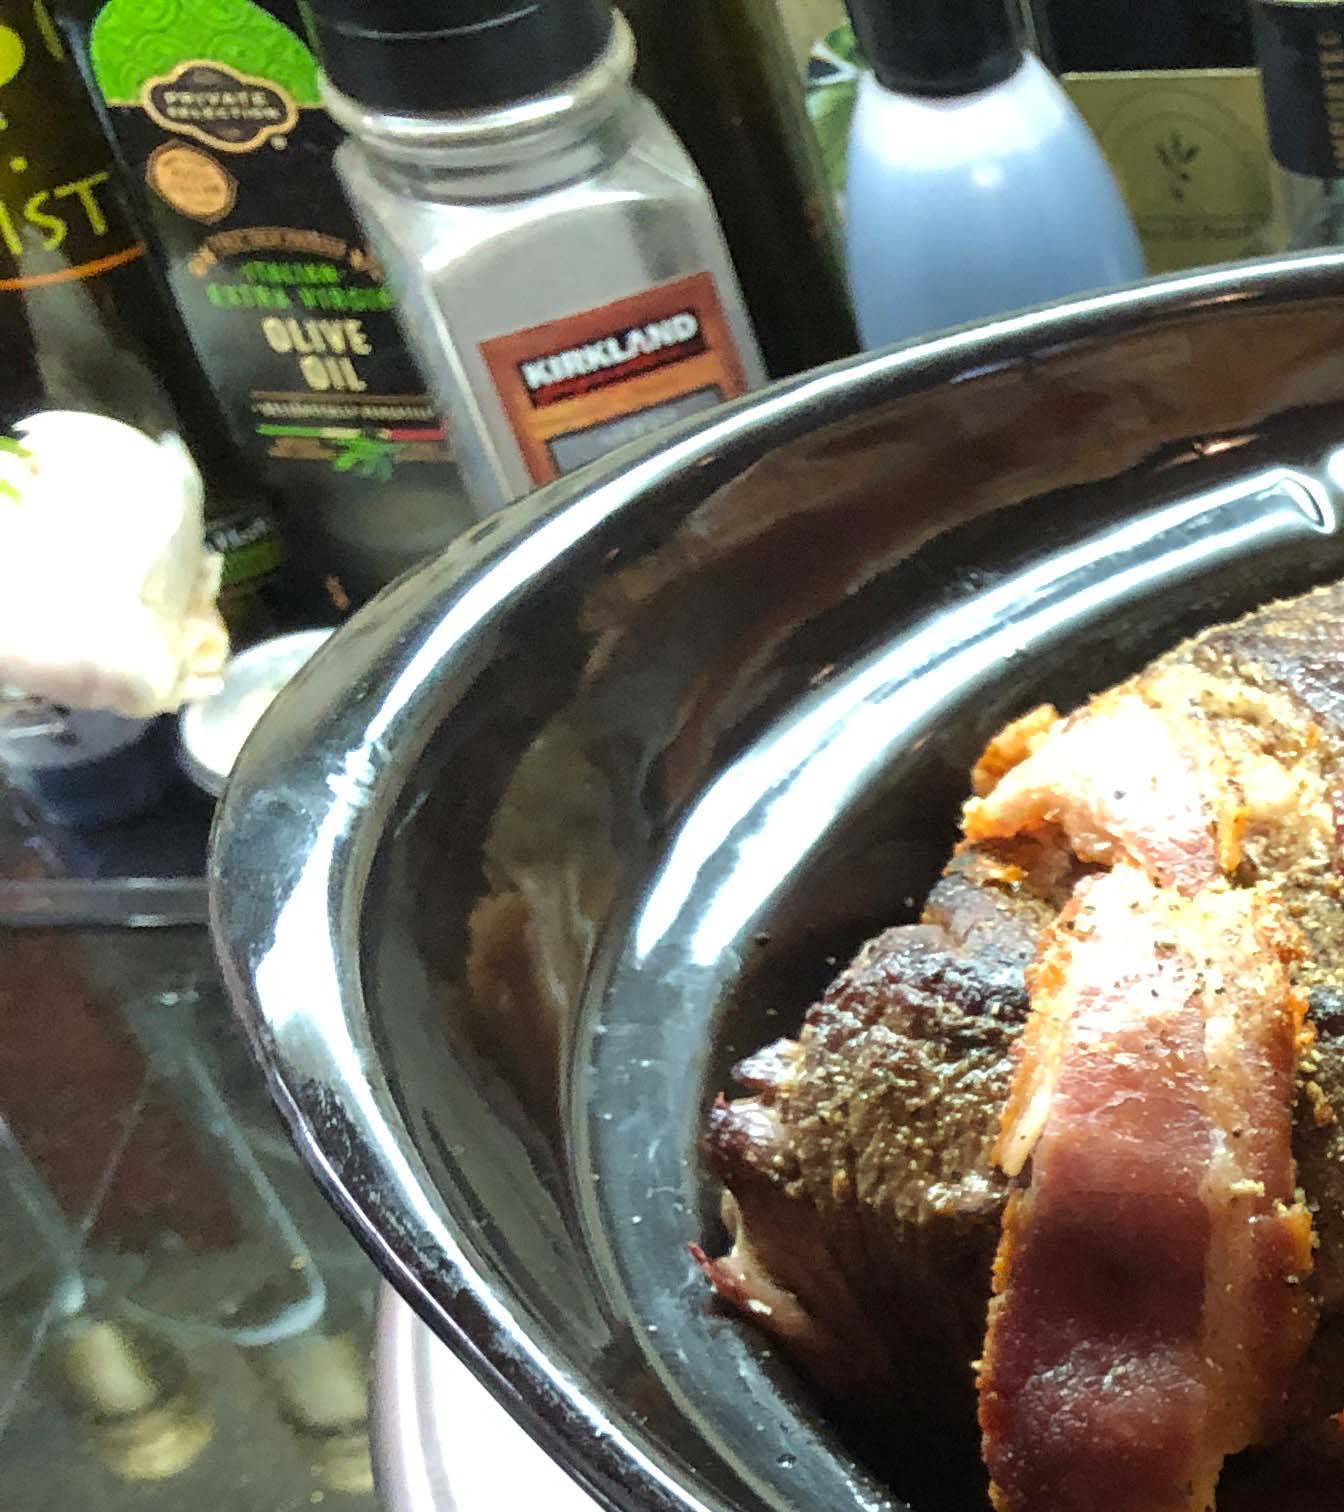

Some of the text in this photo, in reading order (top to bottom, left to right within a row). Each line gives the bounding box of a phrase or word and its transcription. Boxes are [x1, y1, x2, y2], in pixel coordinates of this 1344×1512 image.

[261, 316, 373, 355] OLIVE
[520, 311, 698, 389] KIRKLAND
[299, 354, 368, 392] OIL
